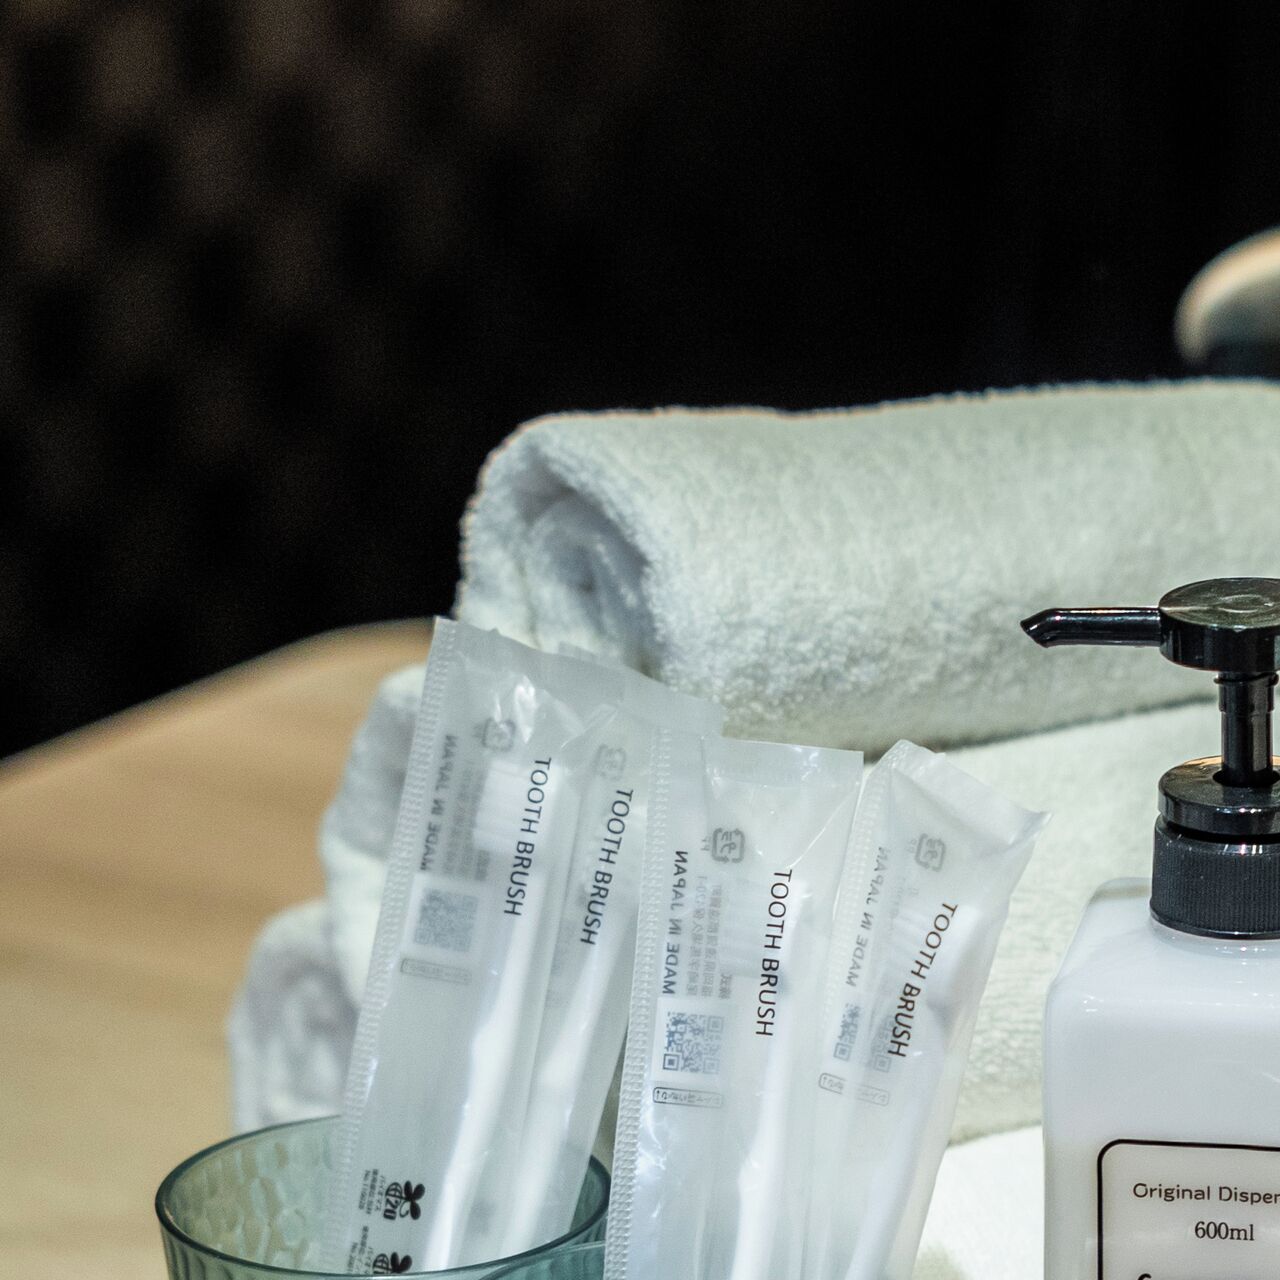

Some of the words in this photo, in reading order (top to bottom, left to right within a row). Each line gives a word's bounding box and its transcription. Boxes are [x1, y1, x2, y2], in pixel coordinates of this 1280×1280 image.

[520, 756, 552, 835] TOOTH
[599, 788, 634, 865] TOOTH
[504, 840, 535, 917] BRUSH
[580, 869, 613, 946] BRUSH
[763, 869, 793, 950] TOOTH
[920, 902, 958, 980] TOOTH
[755, 957, 780, 1037] BRUSH
[887, 981, 921, 1058] BRUSH
[383, 1198, 399, 1220] 20
[1133, 1182, 1211, 1202] Original
[1194, 1220, 1255, 1241] 600ml
